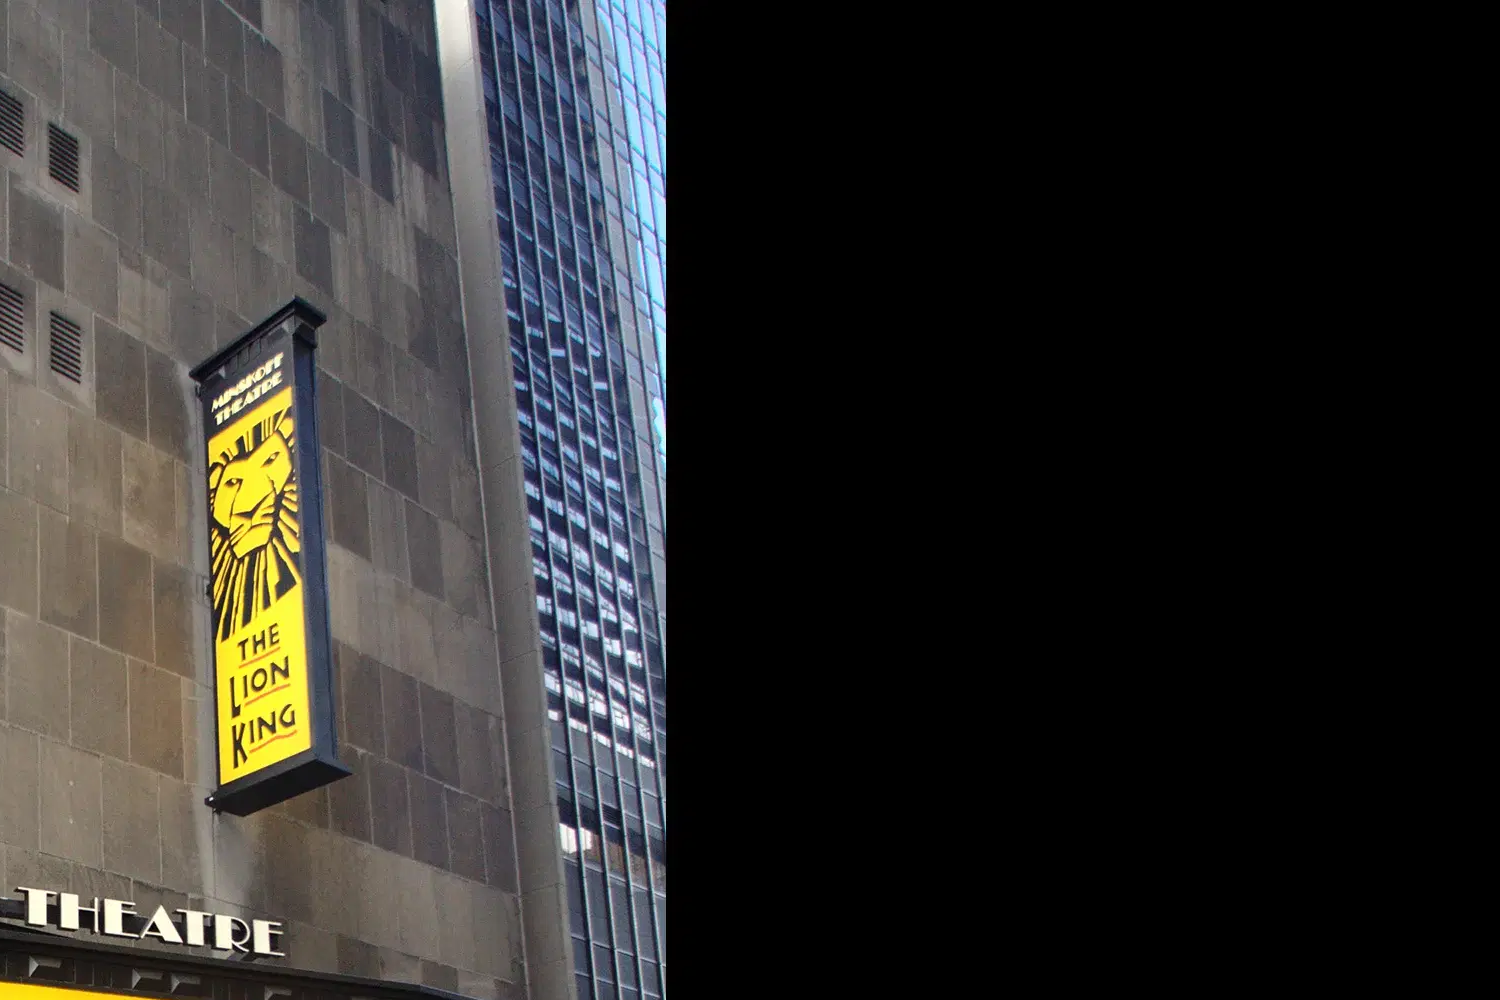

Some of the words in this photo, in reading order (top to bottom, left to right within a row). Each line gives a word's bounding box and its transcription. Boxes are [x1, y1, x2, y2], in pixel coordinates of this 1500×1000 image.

[211, 352, 284, 413] MINSKOFF
[214, 371, 283, 426] THEATRE
[237, 622, 280, 661] THE
[229, 655, 290, 720] LION
[231, 703, 296, 770] KING
[14, 886, 286, 957] THEATRE
